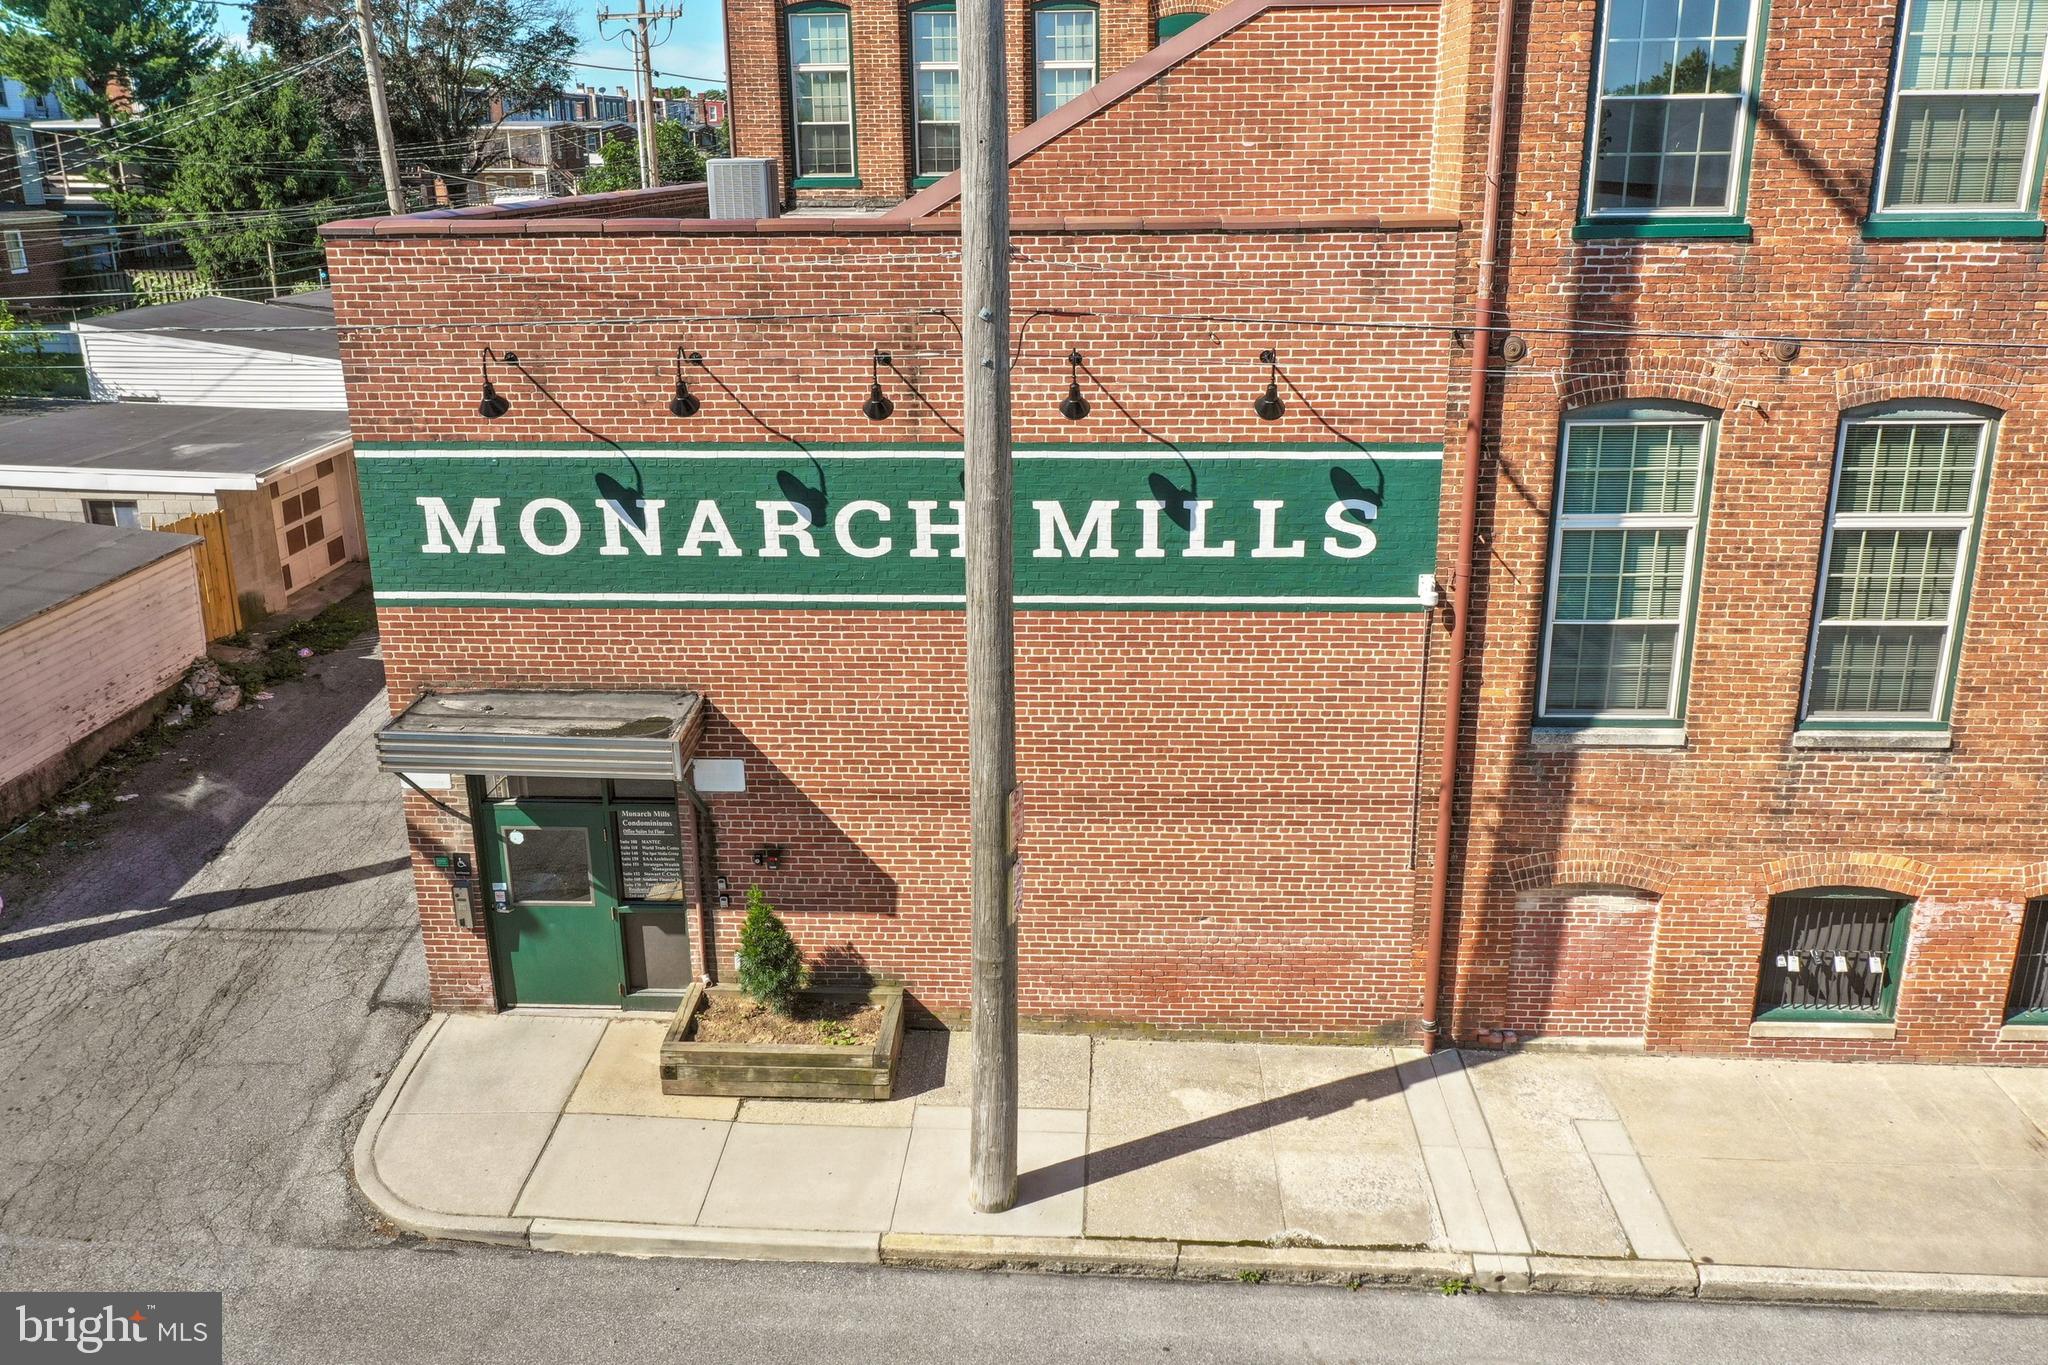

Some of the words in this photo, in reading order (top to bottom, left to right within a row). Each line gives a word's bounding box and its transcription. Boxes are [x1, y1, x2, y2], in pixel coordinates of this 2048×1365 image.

[416, 496, 966, 559] MONARCH
[1031, 498, 1378, 559] MILLS
[622, 819, 673, 827] Condominiums
